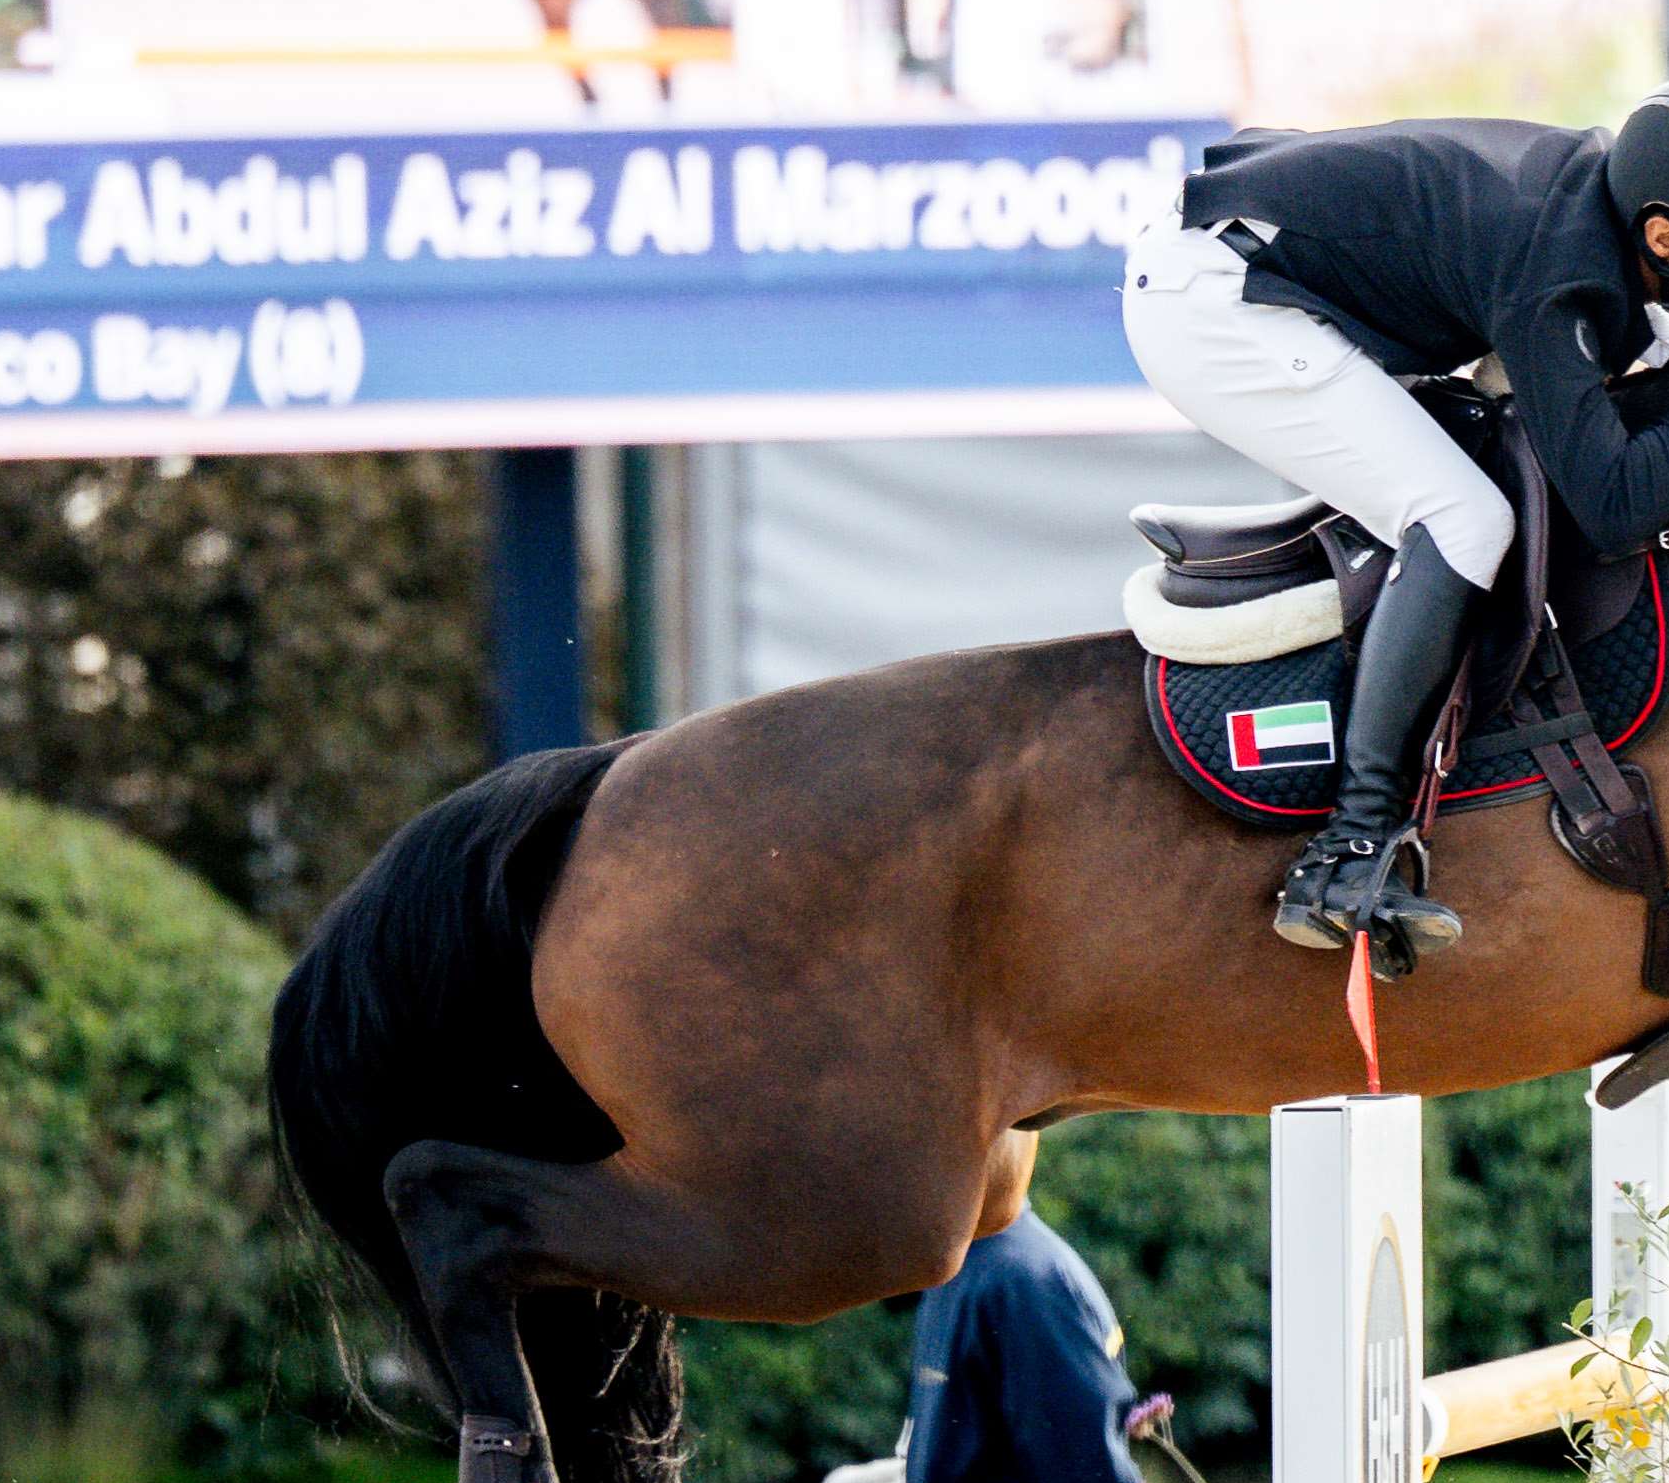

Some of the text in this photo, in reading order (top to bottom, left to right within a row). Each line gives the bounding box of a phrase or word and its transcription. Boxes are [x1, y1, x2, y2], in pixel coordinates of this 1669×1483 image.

[79, 156, 369, 267] Abdul
[385, 151, 597, 260] Aziz
[607, 147, 713, 256] Al
[93, 315, 242, 416] Bay
